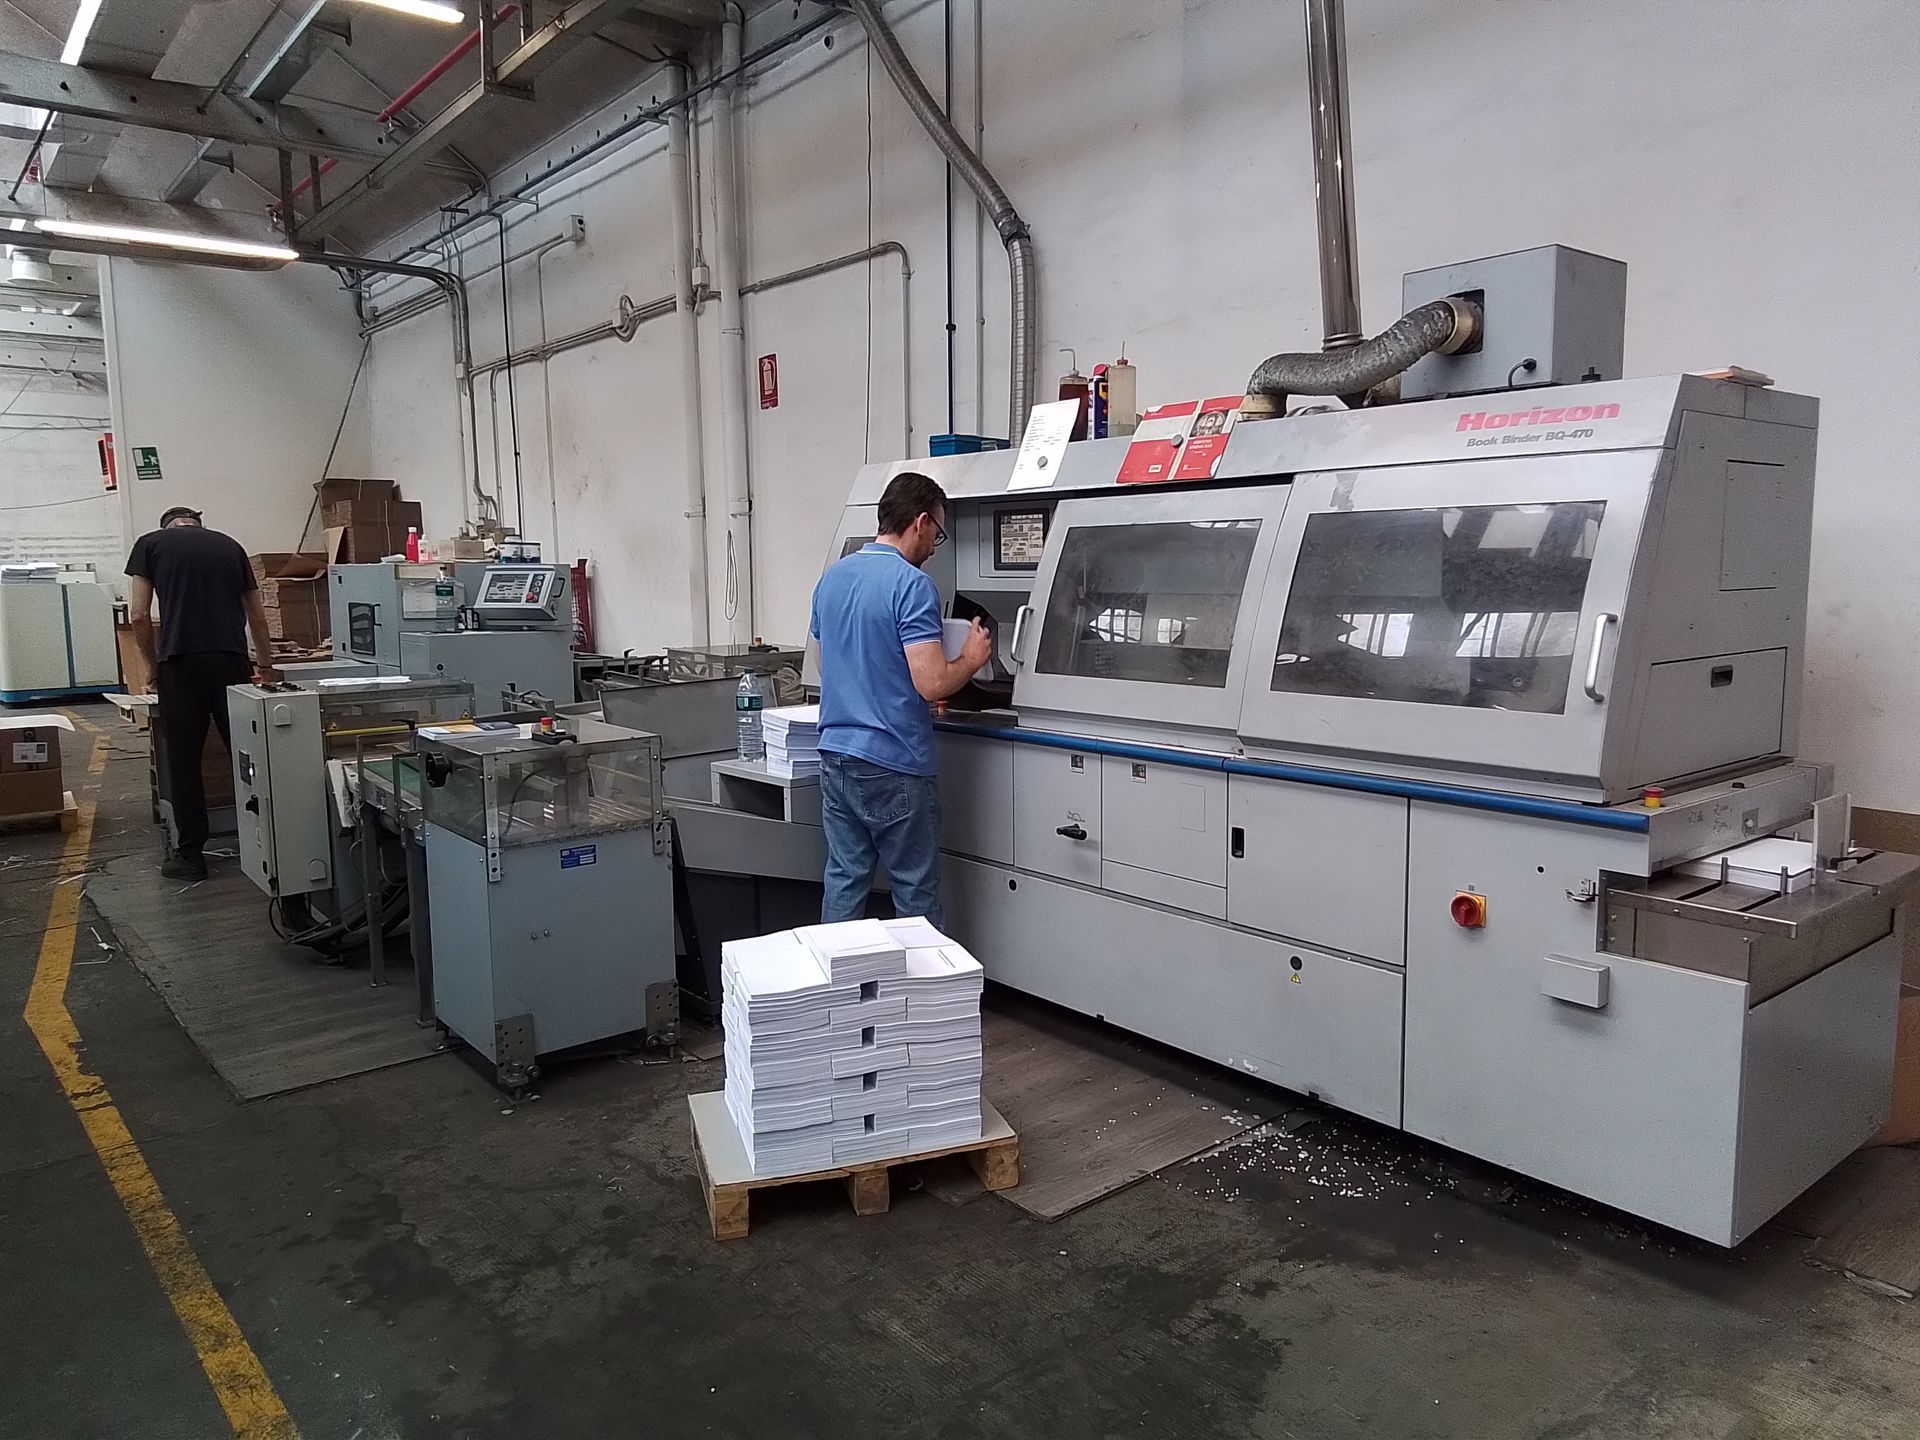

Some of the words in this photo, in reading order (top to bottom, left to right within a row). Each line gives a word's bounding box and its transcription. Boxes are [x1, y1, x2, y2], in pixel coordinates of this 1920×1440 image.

[1456, 403, 1620, 432] Horizon
[1466, 436, 1498, 448] Book
[1502, 433, 1542, 445] Binder
[1544, 428, 1594, 441] BQ-470
